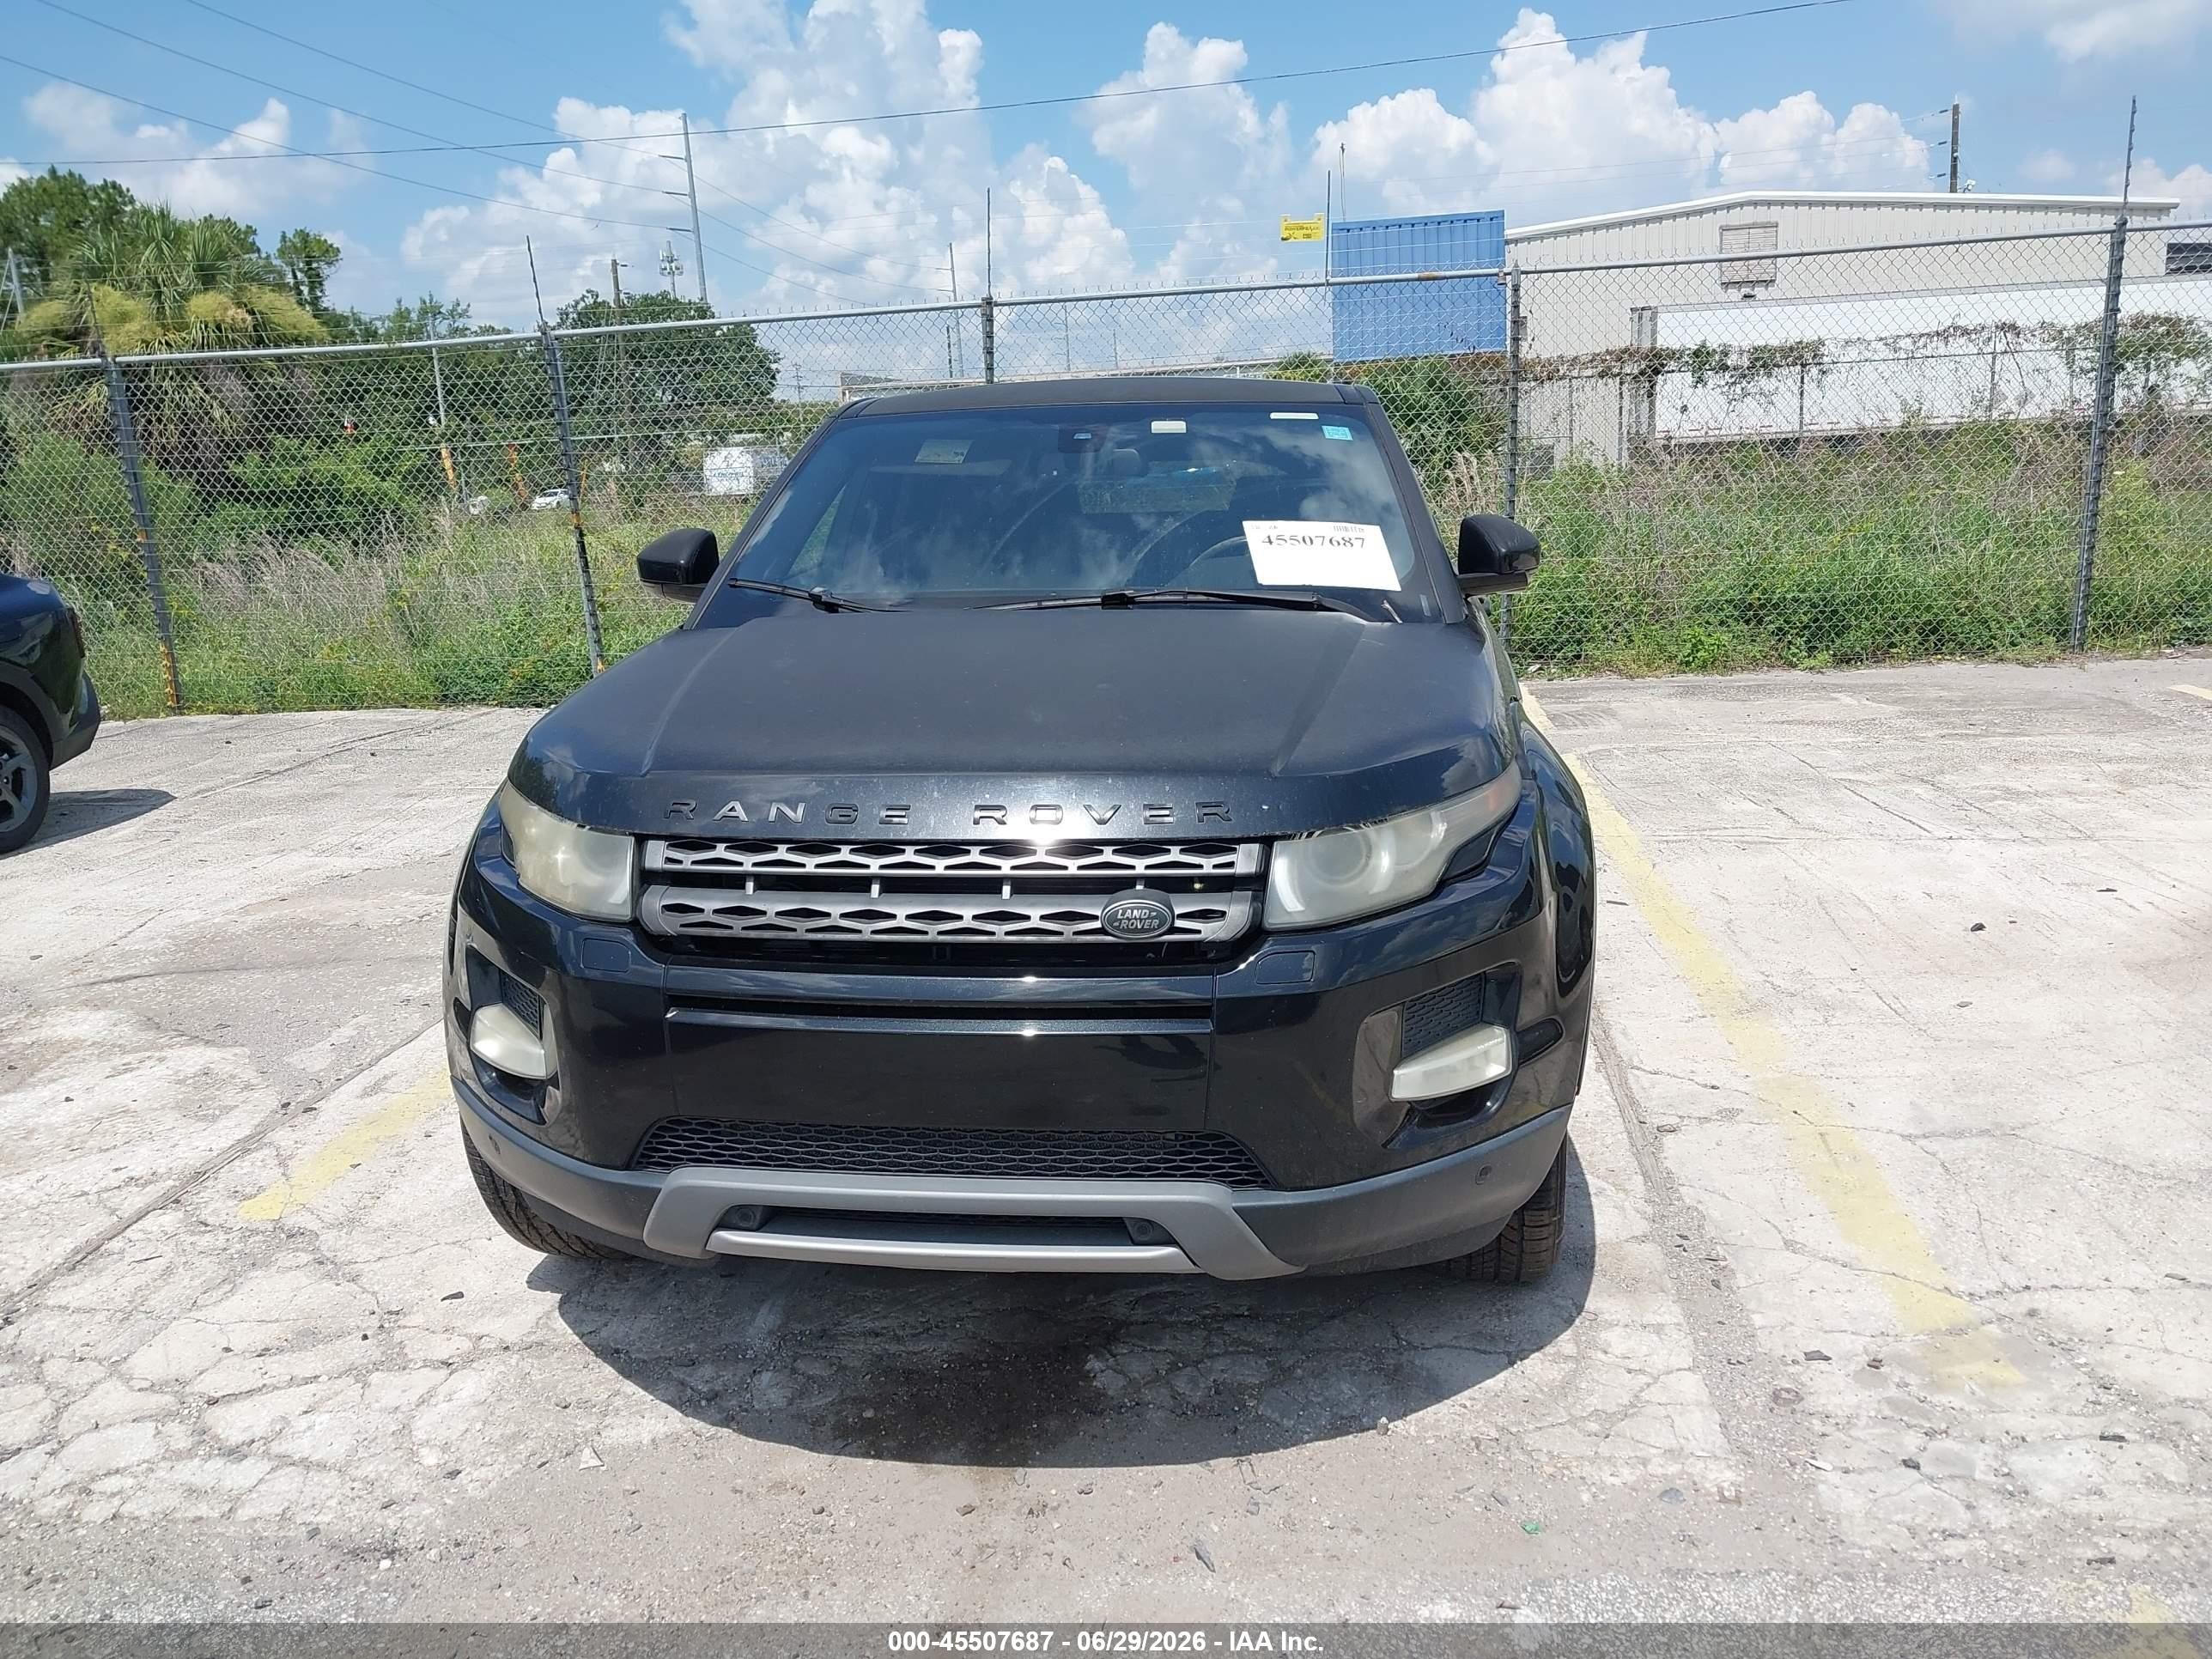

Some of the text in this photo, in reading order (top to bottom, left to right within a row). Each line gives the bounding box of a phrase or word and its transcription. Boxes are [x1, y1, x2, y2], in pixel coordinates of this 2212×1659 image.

[1261, 534, 1366, 549] 45507687
[663, 799, 1233, 826] RANGE ROVER
[1116, 909, 1150, 920] LAND
[1119, 919, 1160, 929] ROVER
